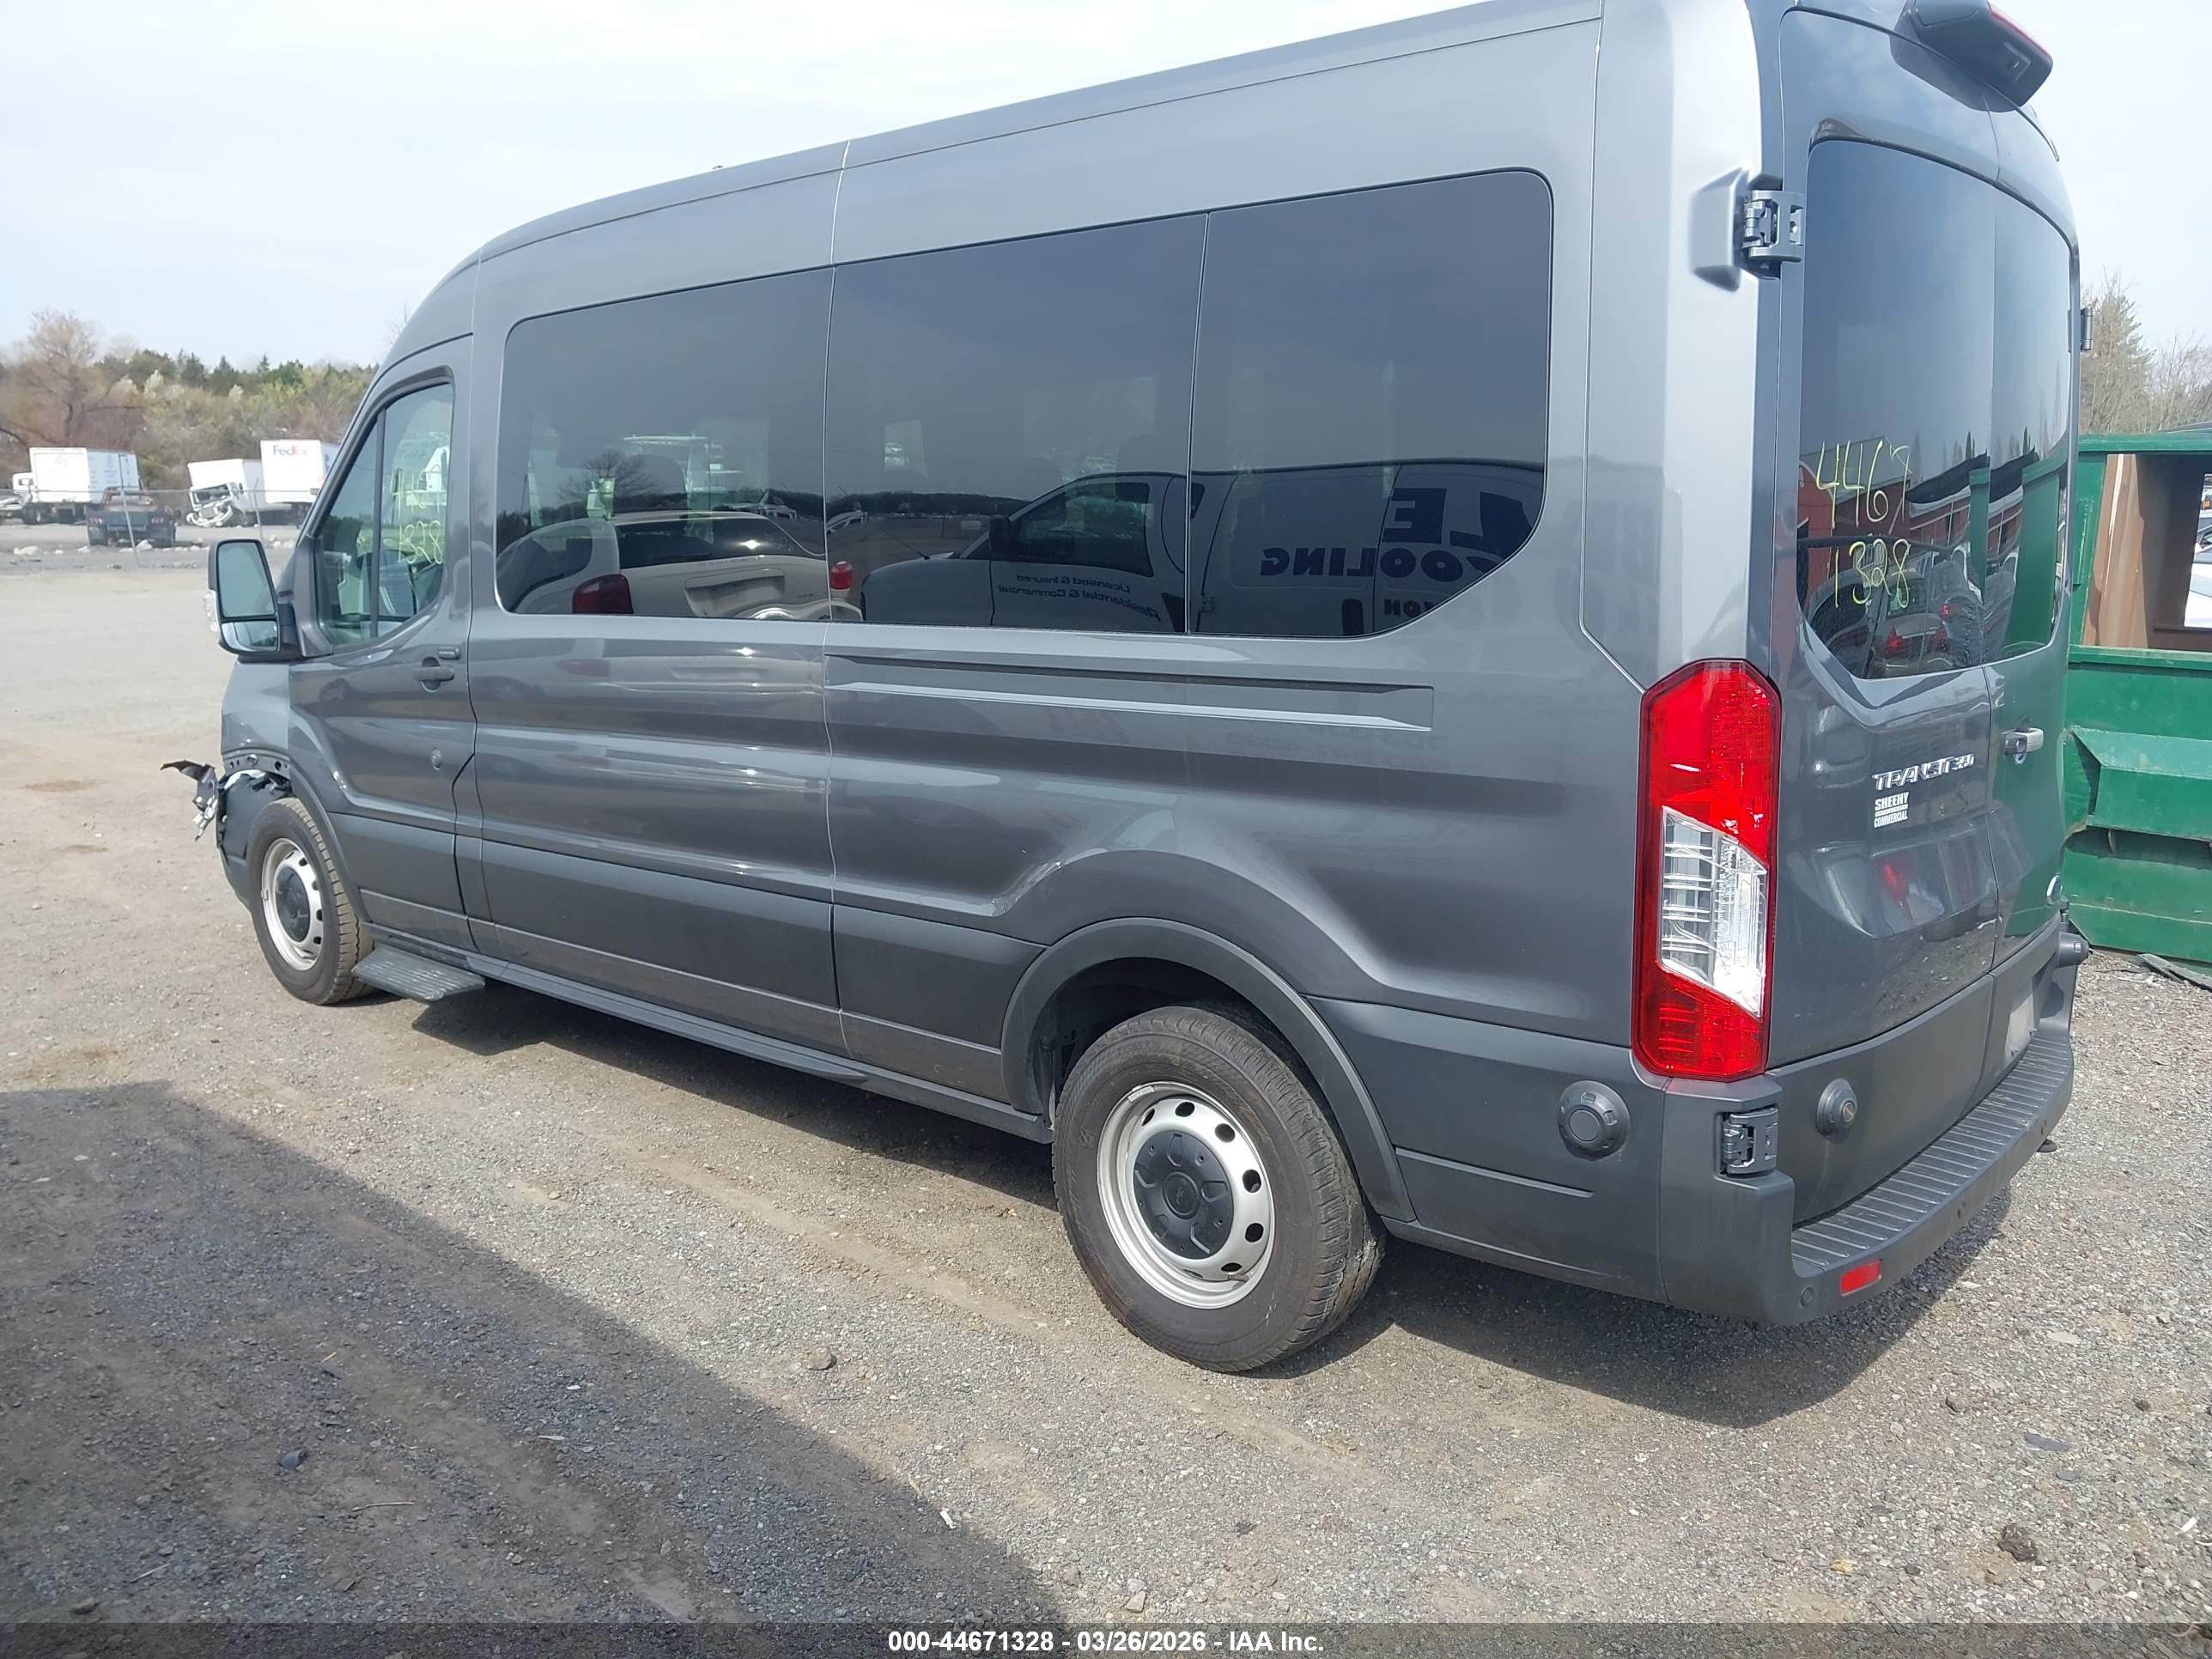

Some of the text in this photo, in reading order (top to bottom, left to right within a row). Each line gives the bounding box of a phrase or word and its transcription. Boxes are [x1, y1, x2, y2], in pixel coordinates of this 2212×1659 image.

[272, 445, 308, 456] FedEx
[1816, 440, 1911, 529] 4467
[398, 520, 443, 564] 1328
[1834, 538, 1911, 608] 1328
[1872, 757, 1954, 790] TRANSIT
[1875, 792, 1909, 811] SHEEHY
[1874, 810, 1908, 828] COMMERCIAL
